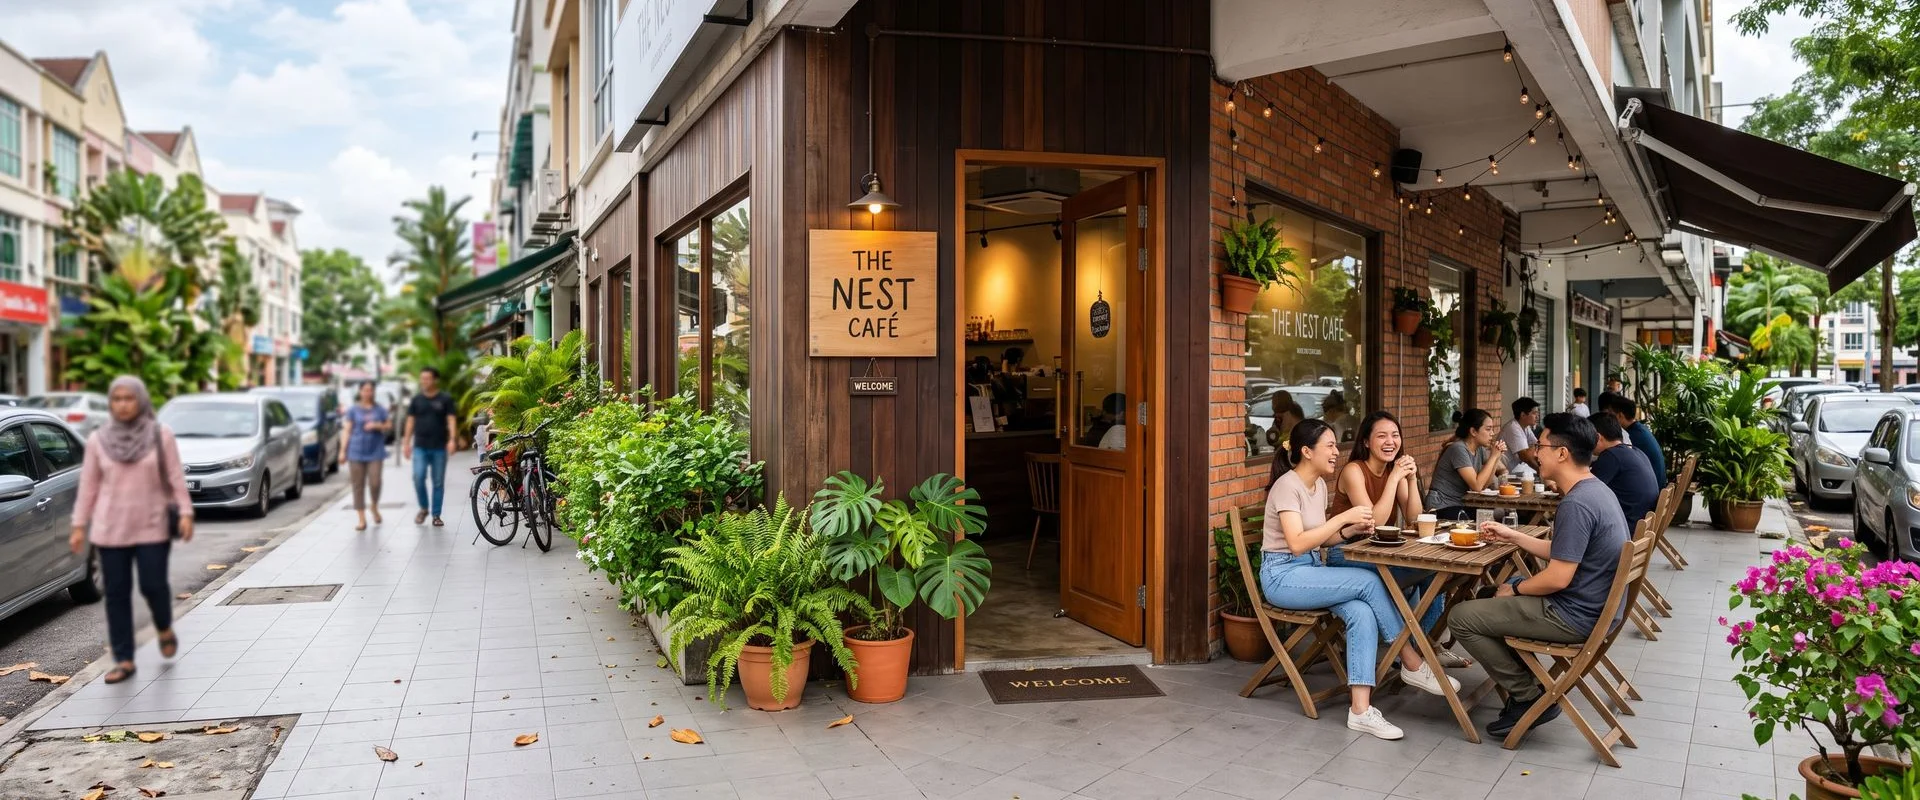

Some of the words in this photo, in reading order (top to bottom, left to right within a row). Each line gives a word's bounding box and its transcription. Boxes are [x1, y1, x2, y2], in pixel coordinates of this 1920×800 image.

[637, 0, 652, 64] THE
[852, 250, 893, 271] THE
[832, 277, 915, 311] NEST
[849, 311, 899, 338] CAFÉ
[1271, 308, 1291, 337] THE
[1295, 311, 1320, 340] NEST
[854, 381, 894, 391] WELCOME
[1009, 676, 1131, 689] WELCOME
